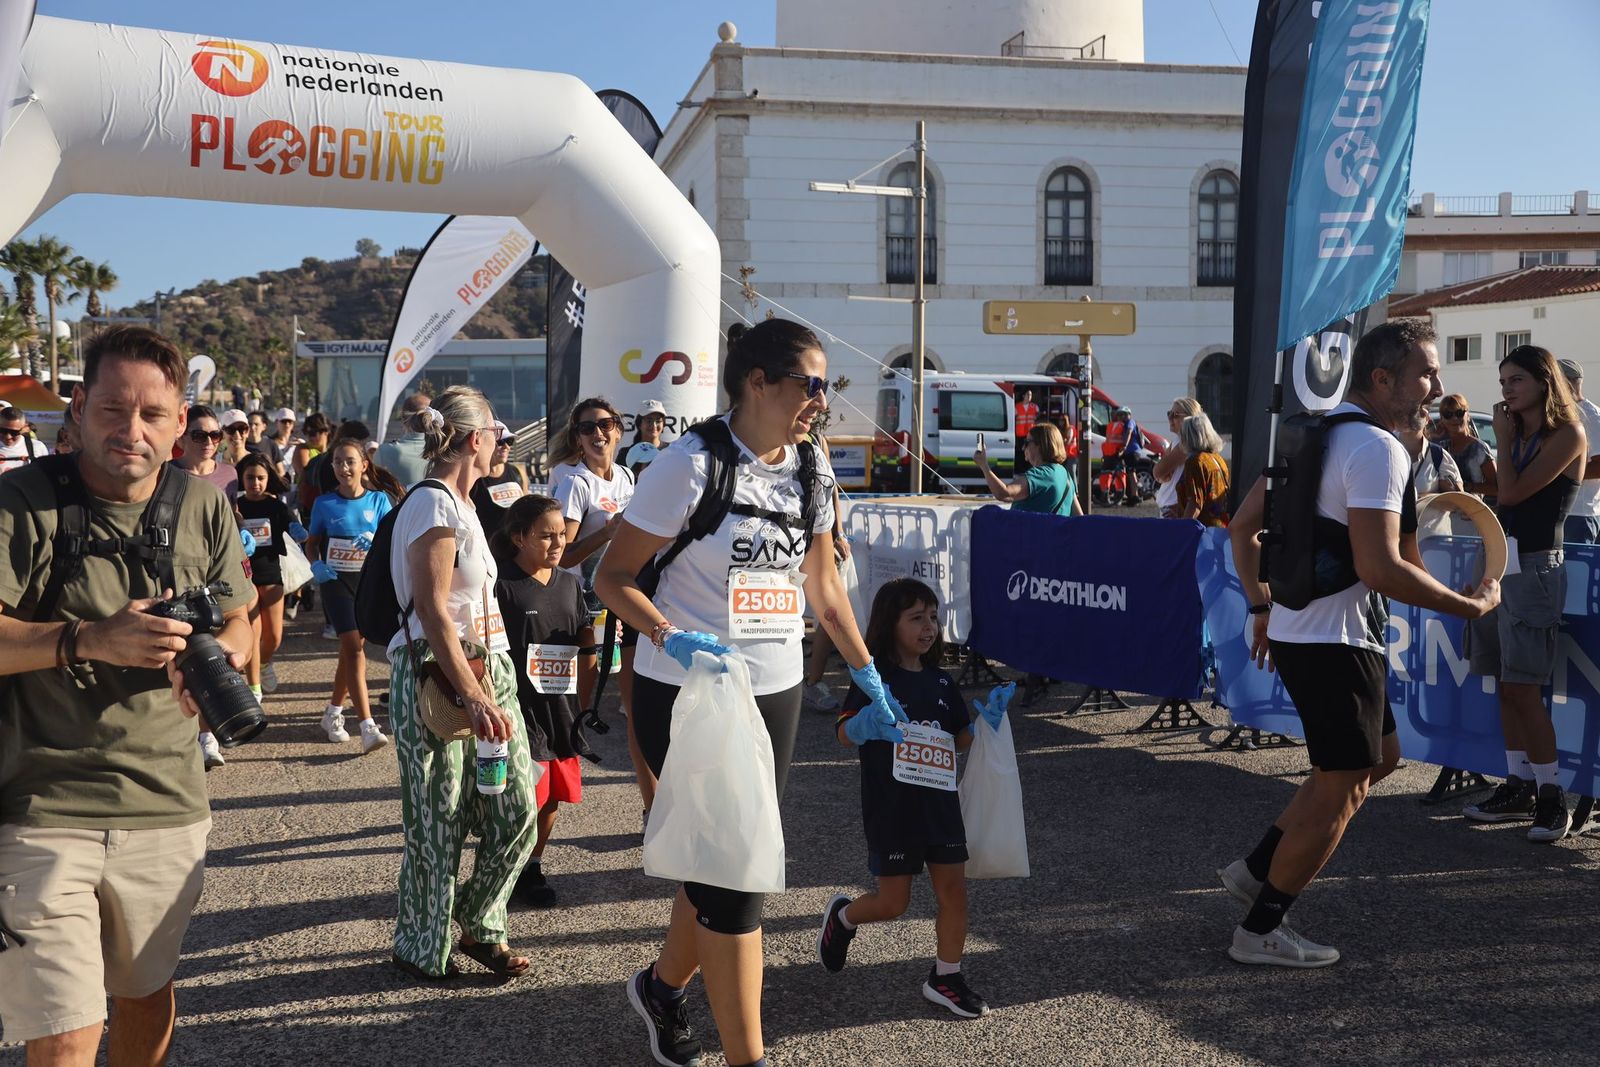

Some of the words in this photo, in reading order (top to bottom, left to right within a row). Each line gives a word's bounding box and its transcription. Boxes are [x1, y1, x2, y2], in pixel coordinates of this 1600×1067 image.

[281, 55, 400, 77] nationale
[286, 71, 444, 102] nederlanden
[384, 110, 445, 133] TOUR
[1318, 0, 1401, 259] PLOGGIN
[410, 311, 441, 347] nationale
[415, 307, 458, 353] nederlanden
[351, 341, 388, 354] MÁLAG
[912, 560, 946, 580] AETIB
[737, 590, 795, 611] 25087
[1029, 576, 1127, 611] DECATHLON
[898, 742, 952, 768] 25086
